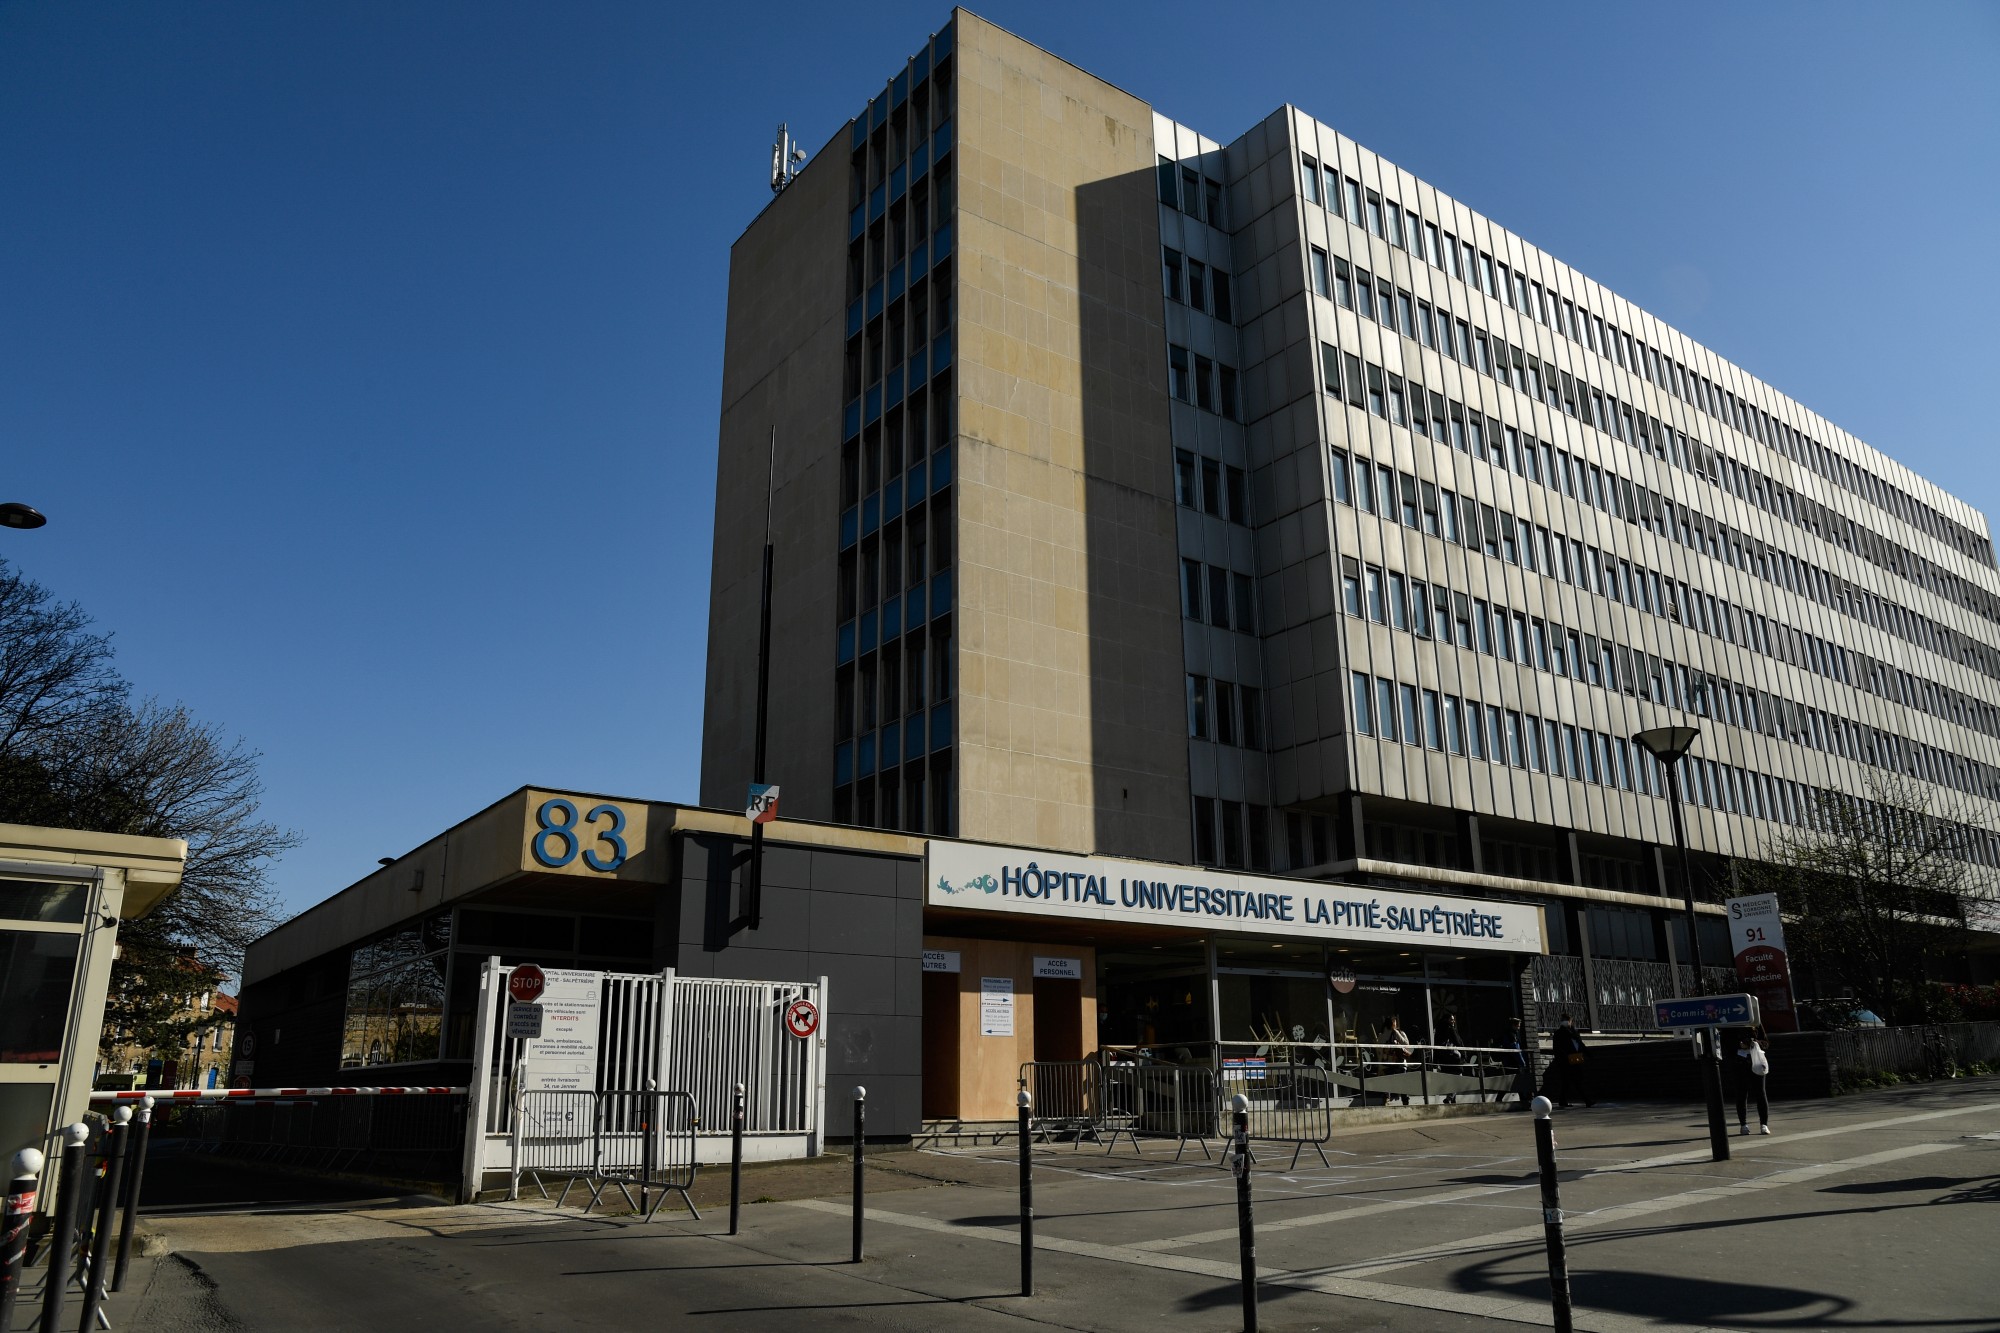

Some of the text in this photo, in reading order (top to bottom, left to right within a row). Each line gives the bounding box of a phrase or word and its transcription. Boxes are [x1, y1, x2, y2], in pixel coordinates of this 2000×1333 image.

[750, 794, 775, 813] RF
[533, 798, 628, 872] 83
[1001, 861, 1504, 939] HÔPITAL UNIVERSITAIRE LA PITIÉ-SALPÊTRIÈRE
[1742, 900, 1771, 908] MÉDECINE
[1743, 905, 1772, 913] SORBONNE
[1746, 927, 1766, 942] 91
[1745, 953, 1774, 963] Faculté
[1040, 968, 1076, 976] PERSONNEL
[1756, 964, 1766, 972] de
[512, 977, 541, 988] STOP
[1744, 973, 1782, 983] médecine
[1670, 1007, 1731, 1018] Commisriat
[244, 1039, 252, 1051] 15
